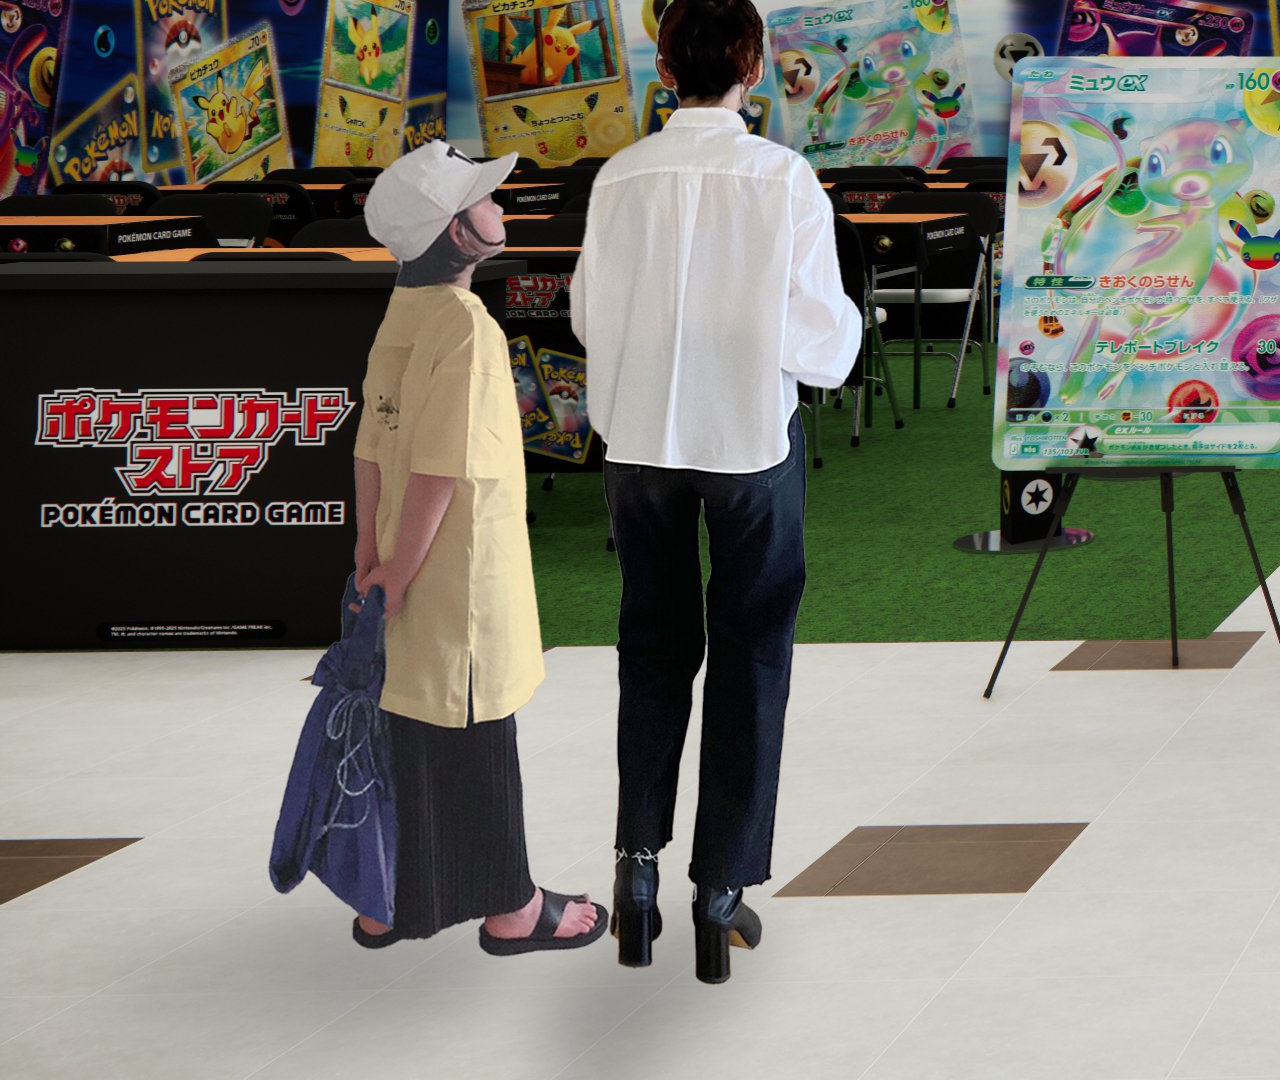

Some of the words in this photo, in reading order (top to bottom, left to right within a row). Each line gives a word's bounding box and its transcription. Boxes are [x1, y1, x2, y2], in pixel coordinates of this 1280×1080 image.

[492, 0, 535, 12] ピカチュウ
[1069, 73, 1148, 92] ミュウex
[1237, 72, 1269, 90] 160
[152, 230, 171, 240] CARD
[172, 228, 192, 238] GAME
[1099, 276, 1194, 288] きおくのらせん
[1096, 341, 1219, 354] テレポートブレイク
[1257, 340, 1277, 354] 30
[34, 388, 356, 447] ポケモンカード
[114, 443, 269, 496] ストア
[41, 498, 177, 527] POKÉMON
[182, 502, 259, 526] CARD
[265, 502, 345, 525] GAME
